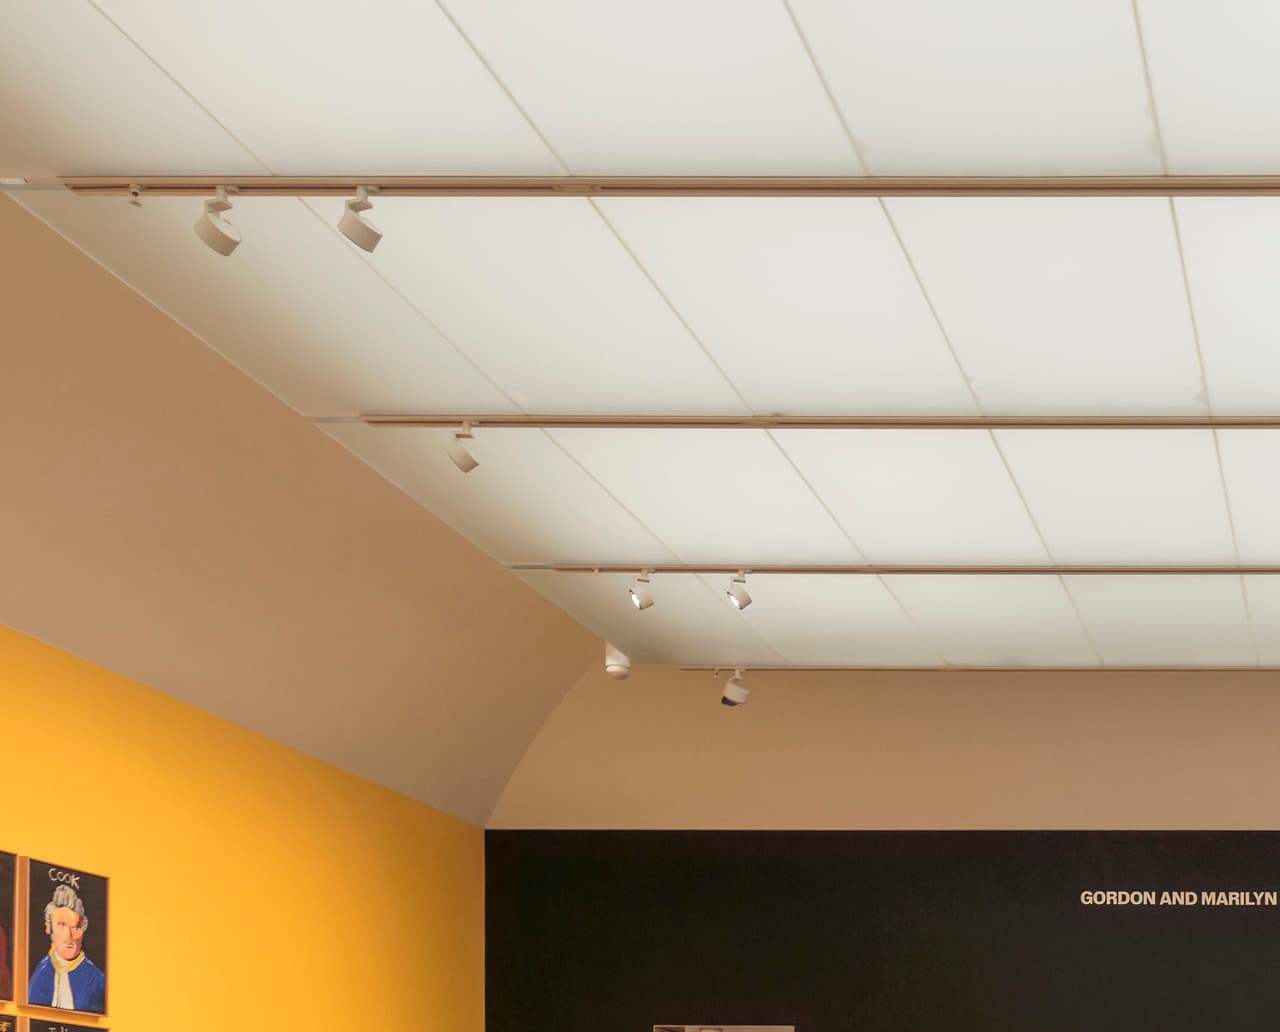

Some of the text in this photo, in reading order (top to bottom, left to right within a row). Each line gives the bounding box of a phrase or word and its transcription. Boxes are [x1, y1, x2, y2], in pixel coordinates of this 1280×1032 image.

[1080, 891, 1156, 905] GORDON
[1160, 891, 1197, 905] AND
[1201, 891, 1277, 905] MARILYN
